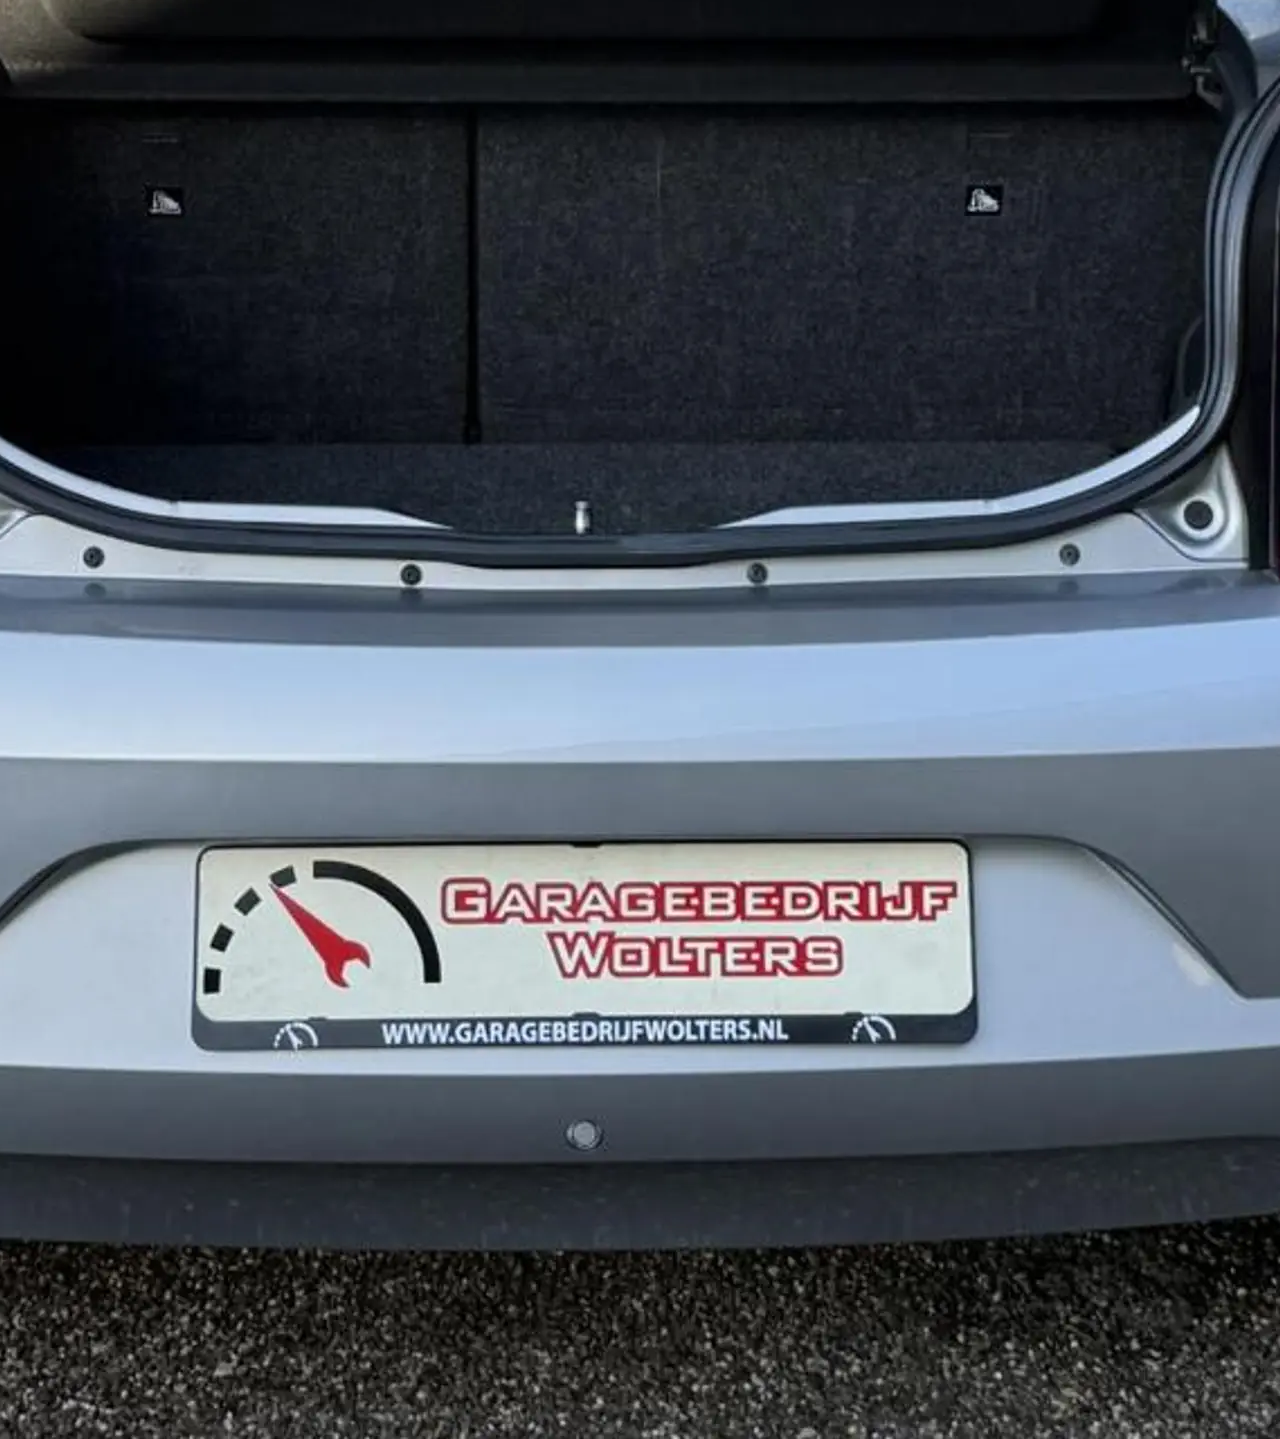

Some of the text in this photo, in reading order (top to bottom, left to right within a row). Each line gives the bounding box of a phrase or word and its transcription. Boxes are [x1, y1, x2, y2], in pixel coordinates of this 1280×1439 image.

[441, 877, 958, 924] GARAGEBEDRIJF
[546, 931, 844, 978] WOLTERS
[380, 1018, 789, 1045] WWW.GARAGEBEDRIJFWOLTERS.NL
